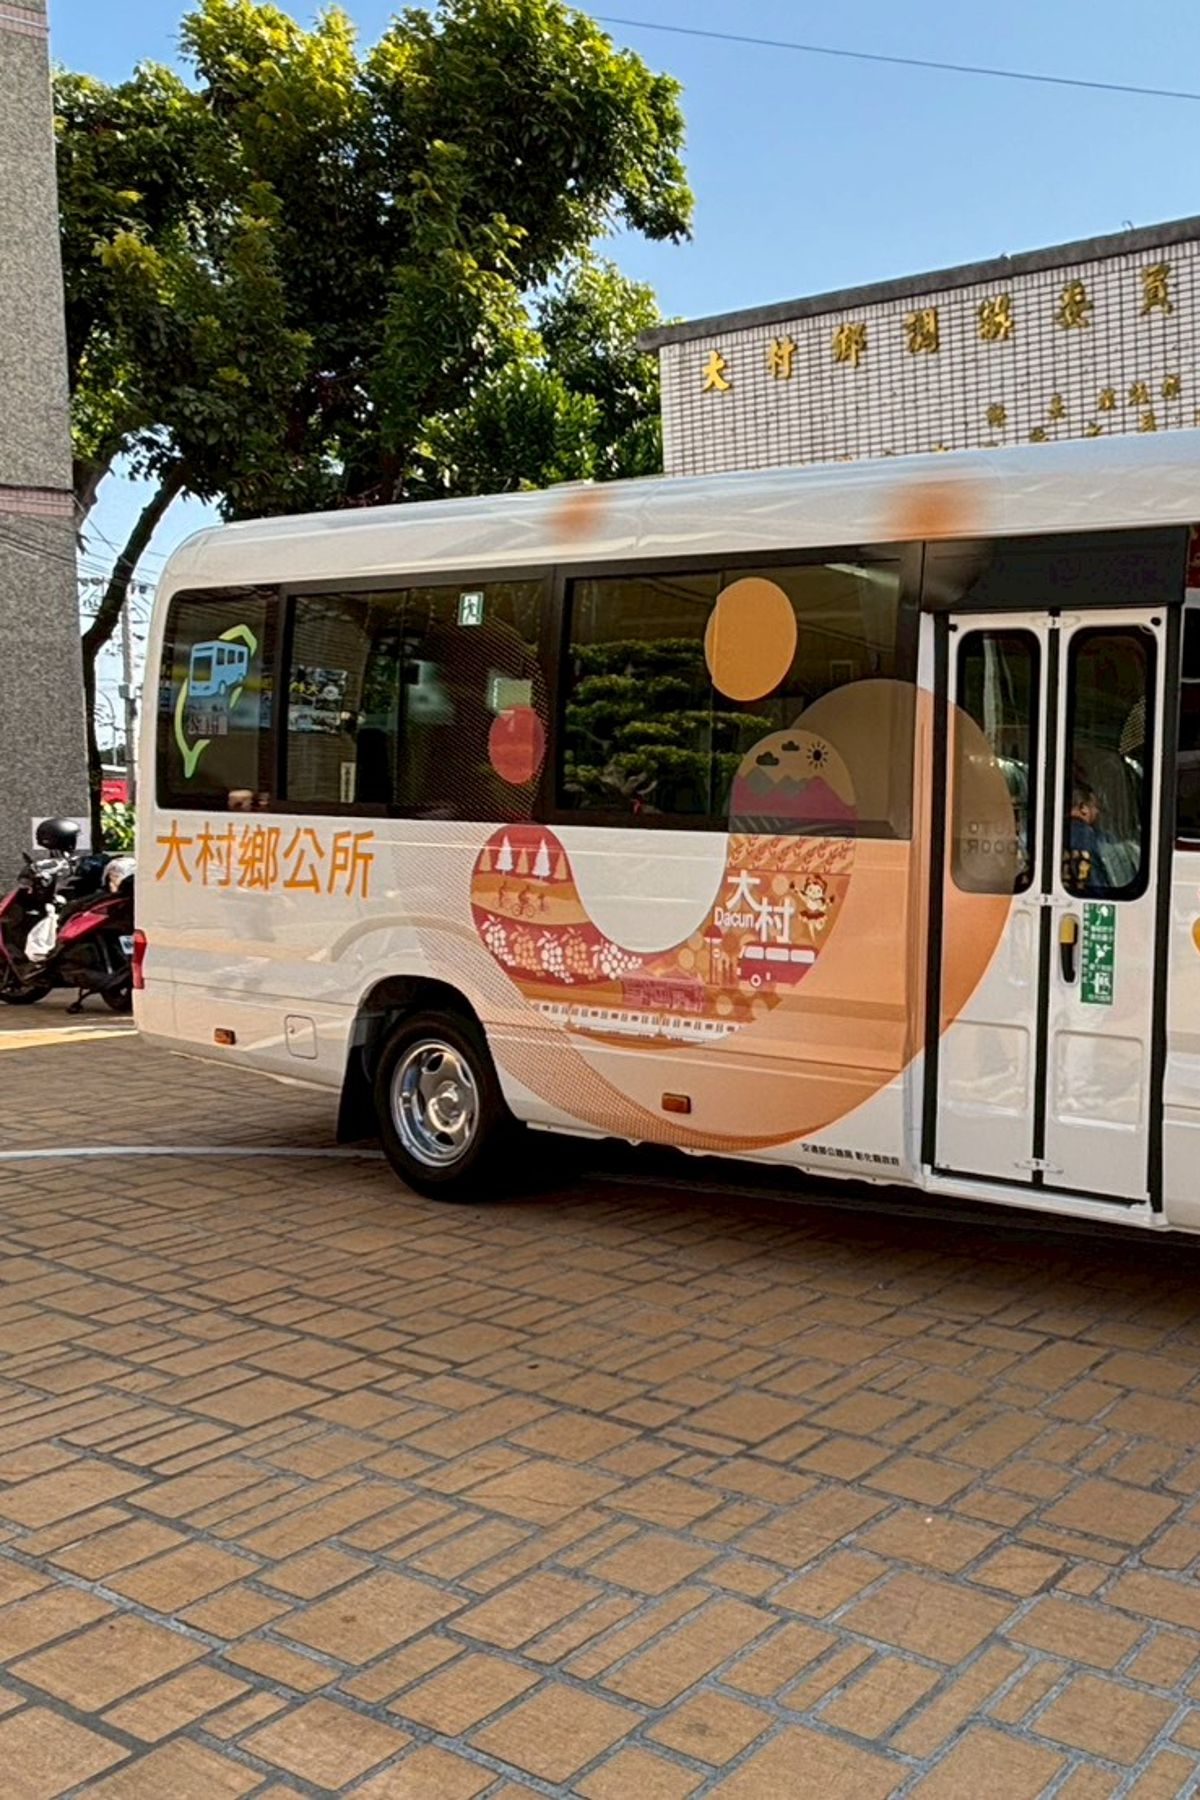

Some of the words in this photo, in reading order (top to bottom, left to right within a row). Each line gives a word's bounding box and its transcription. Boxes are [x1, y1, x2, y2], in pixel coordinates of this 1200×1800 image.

[155, 819, 376, 899] 大村鄉公所
[714, 906, 755, 928] Dacun
[725, 869, 796, 944] 大村
